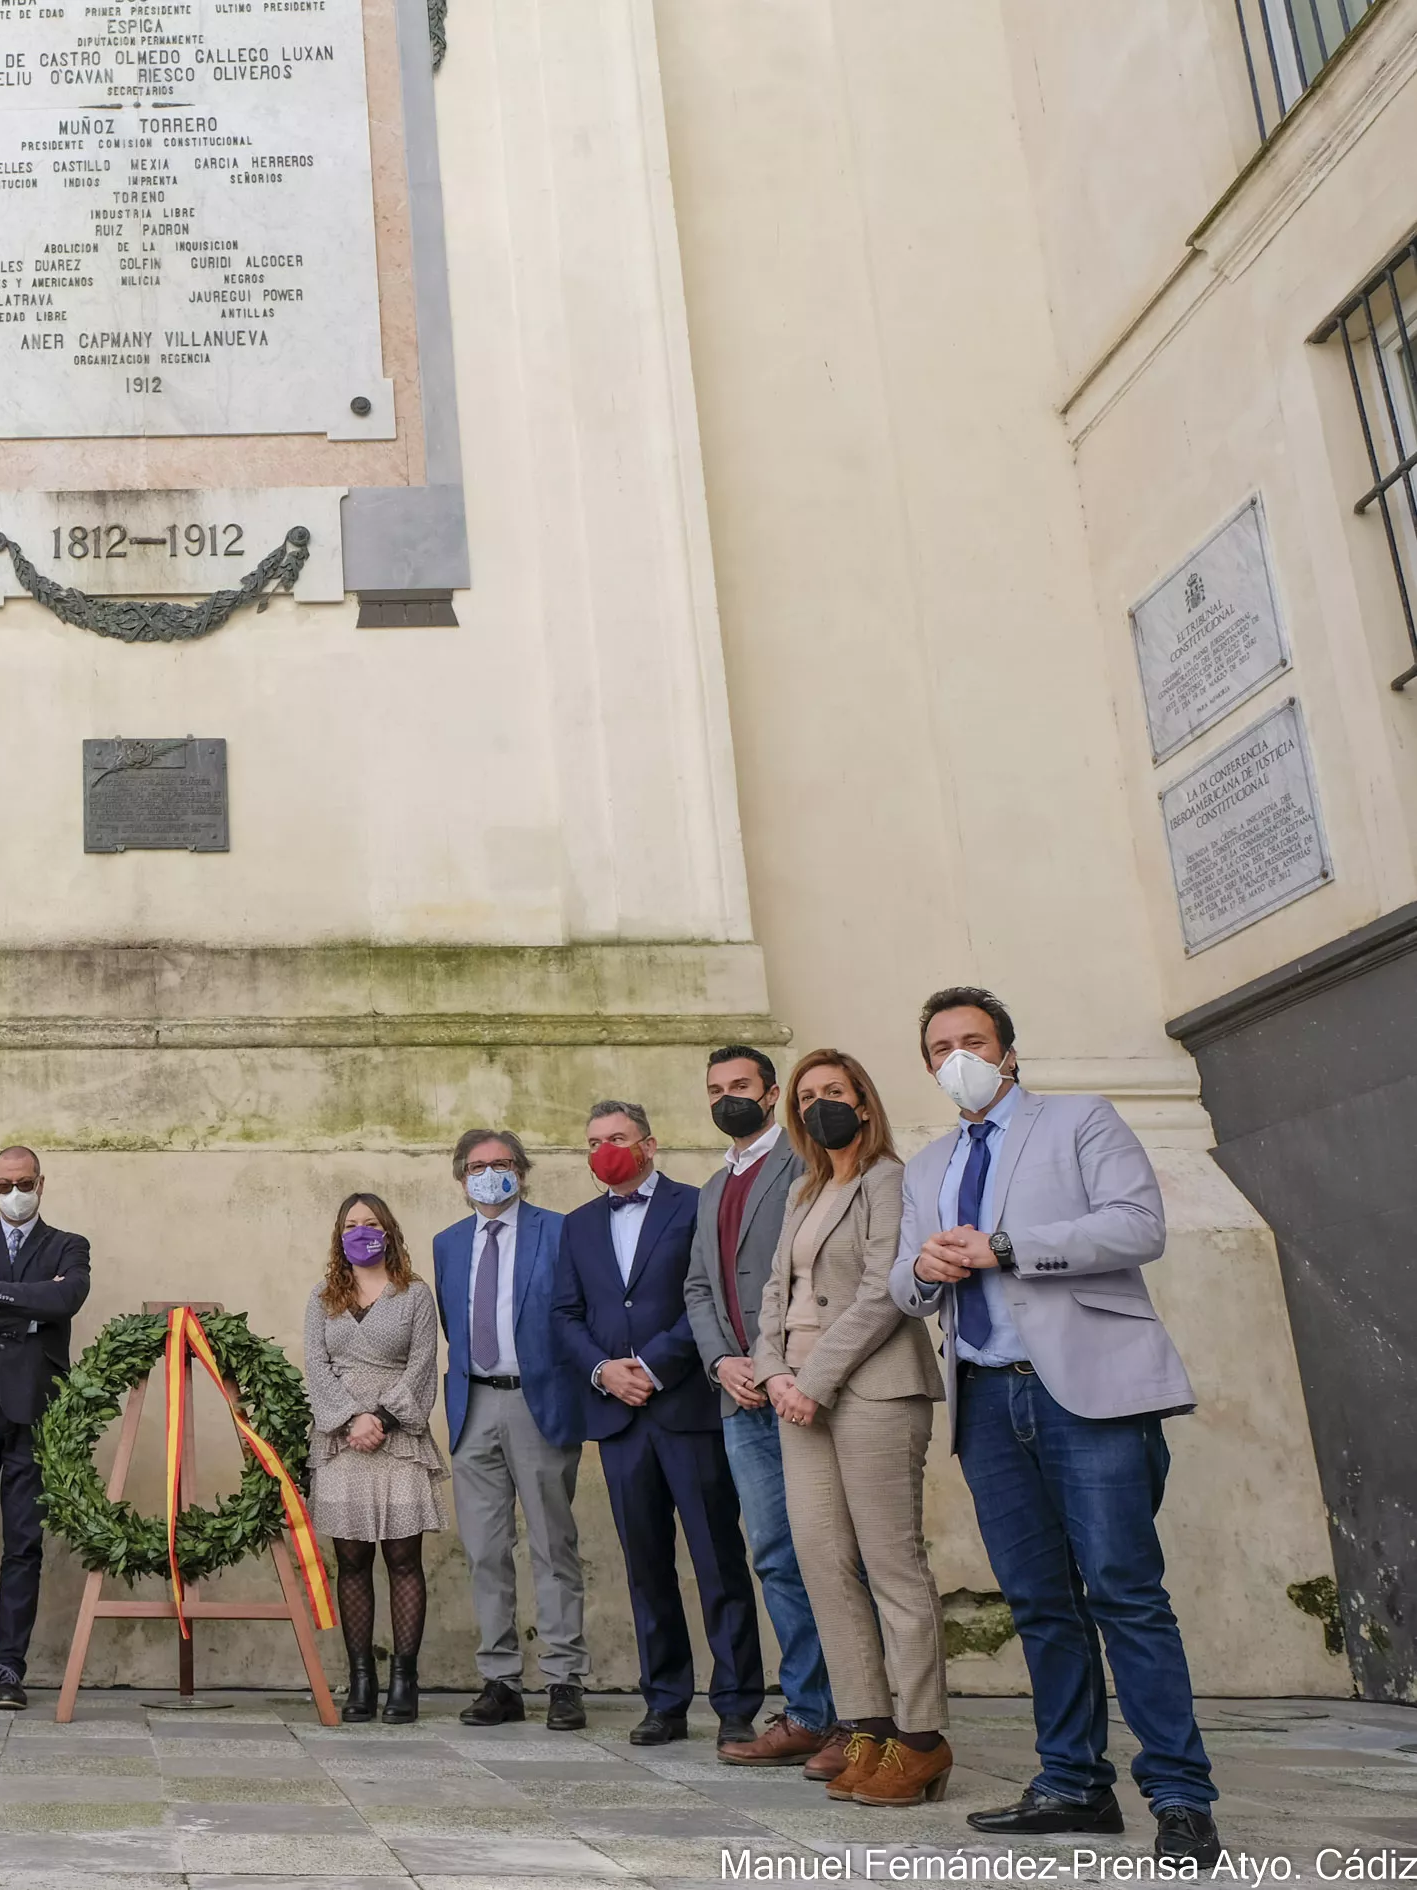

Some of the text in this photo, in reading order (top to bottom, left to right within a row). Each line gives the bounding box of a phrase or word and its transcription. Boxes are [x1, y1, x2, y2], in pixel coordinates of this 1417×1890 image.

[19, 9, 31, 19] DE
[39, 9, 65, 18] EDAD
[85, 5, 191, 17] PRIMER PRESIDENTE
[216, 1, 325, 13] ULTIMO PRESIDENTE
[107, 19, 164, 34] ESPIGA
[77, 35, 204, 47] DIPUTACION PERMANENTE
[6, 53, 25, 68] DE
[39, 51, 101, 67] CASTRO
[115, 50, 180, 65] OLMEDO
[195, 48, 269, 64] GALLEGO
[282, 46, 333, 61] LUXAN
[138, 67, 195, 83] RIESCO
[213, 65, 292, 81] OLIVEROS
[107, 86, 174, 96] SECRETARIOS
[59, 116, 217, 135] MUÑOZ TORRERO
[21, 136, 252, 151] PRESIDENTE COMISION CONSTITUCIONAL
[53, 160, 111, 173] CASTILLO
[131, 158, 169, 171] MEXIA
[195, 157, 239, 169] GARCIA
[252, 155, 314, 169] HERREROS
[64, 178, 100, 188] INDIOS
[128, 176, 178, 186] IMPRENTA
[230, 172, 283, 184] SEÑORIOS
[113, 191, 165, 204] TORENO
[90, 208, 195, 219] INDUSTRIA LIBRE
[95, 223, 189, 237] RUIZ PADRON
[44, 240, 239, 253] ABOLICION DE LA INQUISICION
[35, 259, 82, 272] DUAREZ
[120, 257, 162, 270] GOLFIN
[191, 256, 231, 269] GURIDI
[246, 255, 303, 268] ALCOCER
[16, 278, 22, 288] Y
[31, 277, 94, 288] AMERICANOS
[121, 276, 161, 286] MILICIA
[224, 274, 265, 284] NEGROS
[189, 290, 251, 303] JAUREGUI
[263, 289, 303, 301] POWER
[36, 311, 67, 322] LIBRE
[221, 308, 275, 319] ANTILLAS
[21, 330, 269, 350] ANER CAPMANY VILLANUEVA
[74, 353, 211, 366] ORGANIZACION REGENCIA
[125, 376, 163, 394] 1912
[1183, 599, 1223, 636] TRIBUNAL
[1169, 603, 1235, 663] CONSTITUCIONAL
[1209, 740, 1268, 786] CONFERENCIA
[1169, 777, 1240, 830] IBEROAMERICANA
[1255, 739, 1295, 775] JUSTICIA
[1196, 773, 1269, 828] CONSTITUCIONAL
